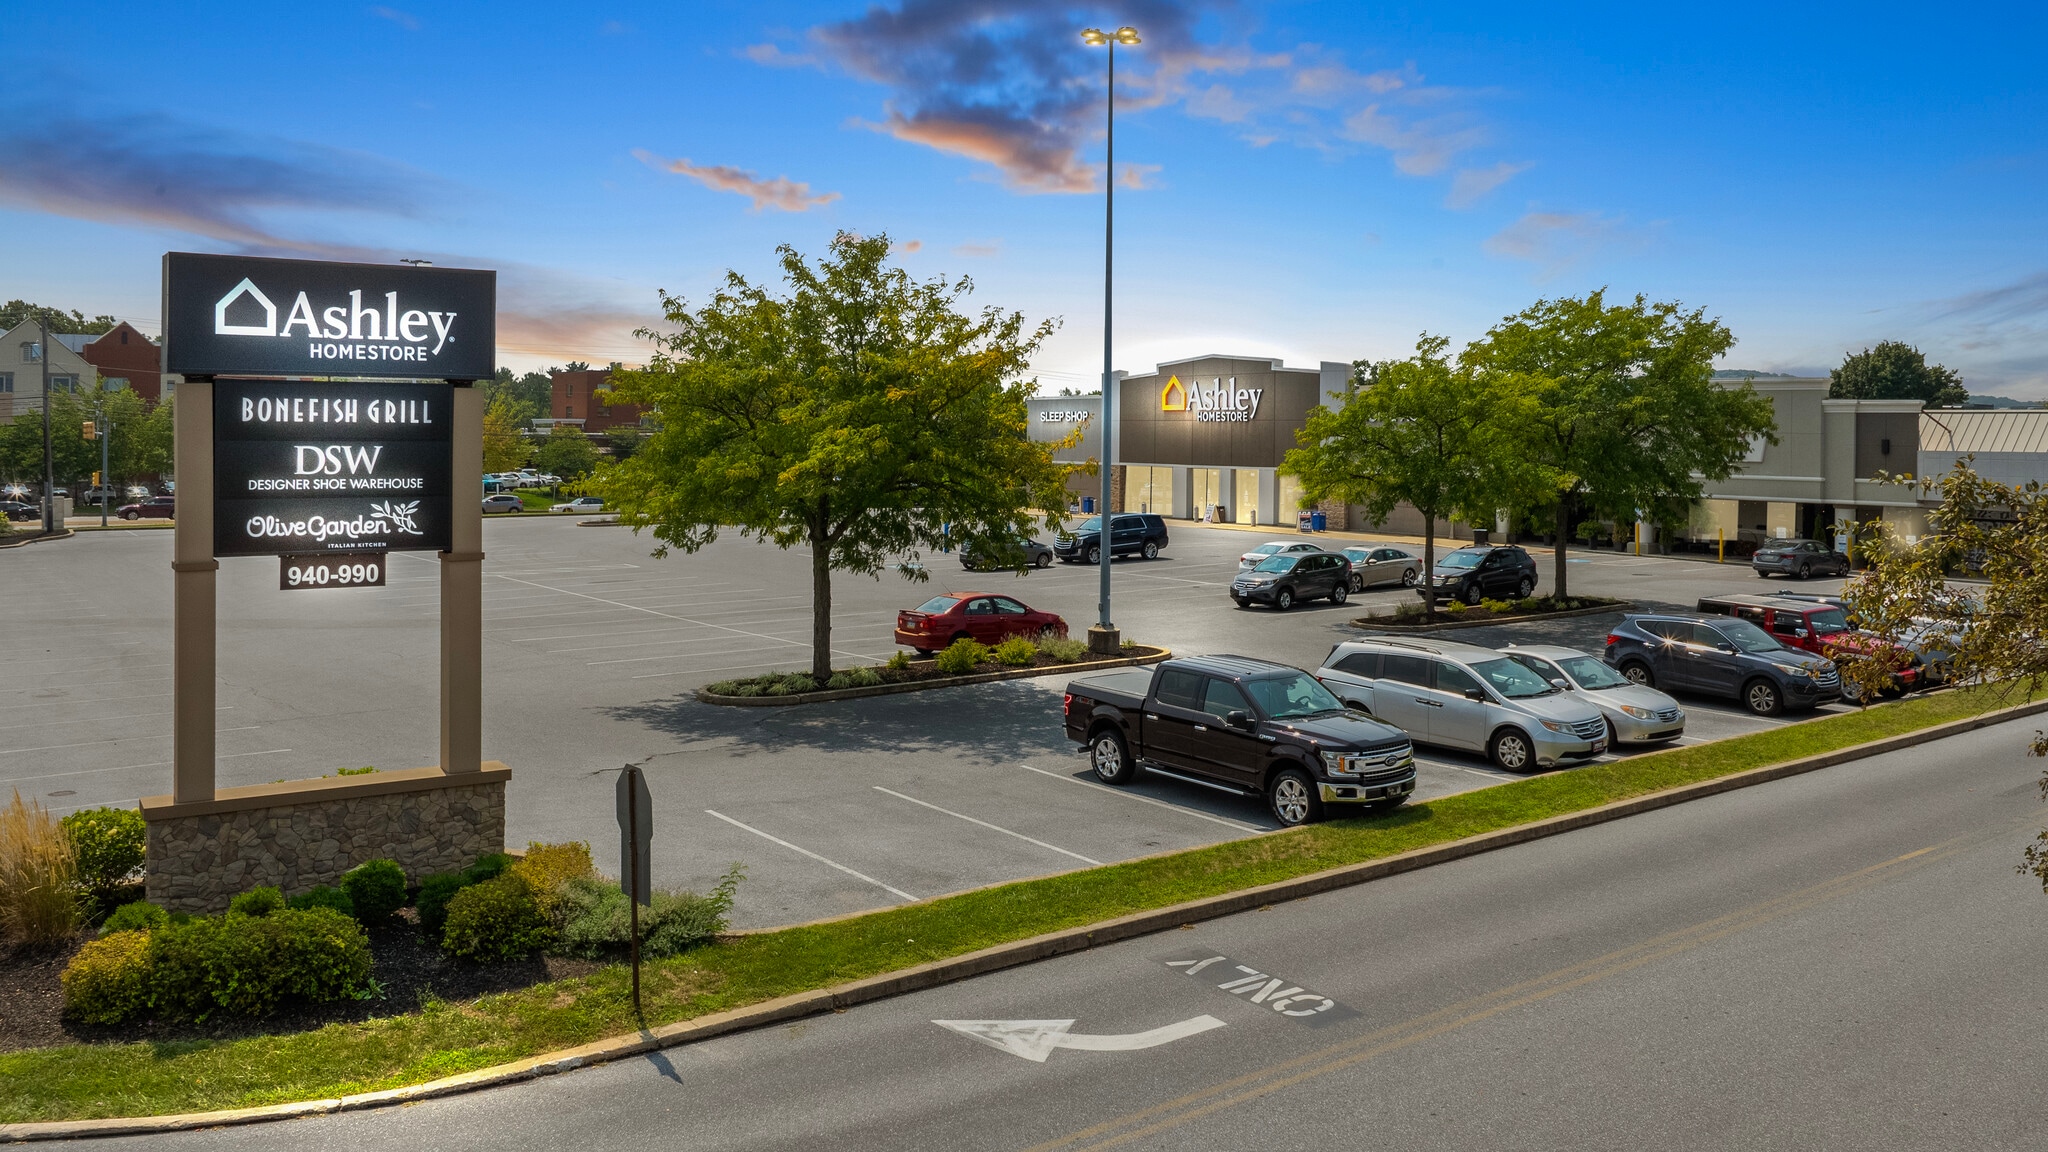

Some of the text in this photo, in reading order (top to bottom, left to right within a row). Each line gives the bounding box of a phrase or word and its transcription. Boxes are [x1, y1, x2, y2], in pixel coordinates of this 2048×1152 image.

[280, 289, 457, 354] Ashley
[310, 343, 427, 361] HOMESTORE
[1186, 377, 1262, 419] Ashley
[242, 397, 432, 424] BONEFISH GRILL
[1040, 411, 1088, 422] SLEEP SHOP
[1197, 411, 1248, 422] HOMESTORE
[294, 445, 383, 475] DSW
[248, 478, 423, 491] DESIGNER SHOE WAREHOUSE
[288, 564, 379, 586] 940-990
[1165, 956, 1334, 1017] ONLY
